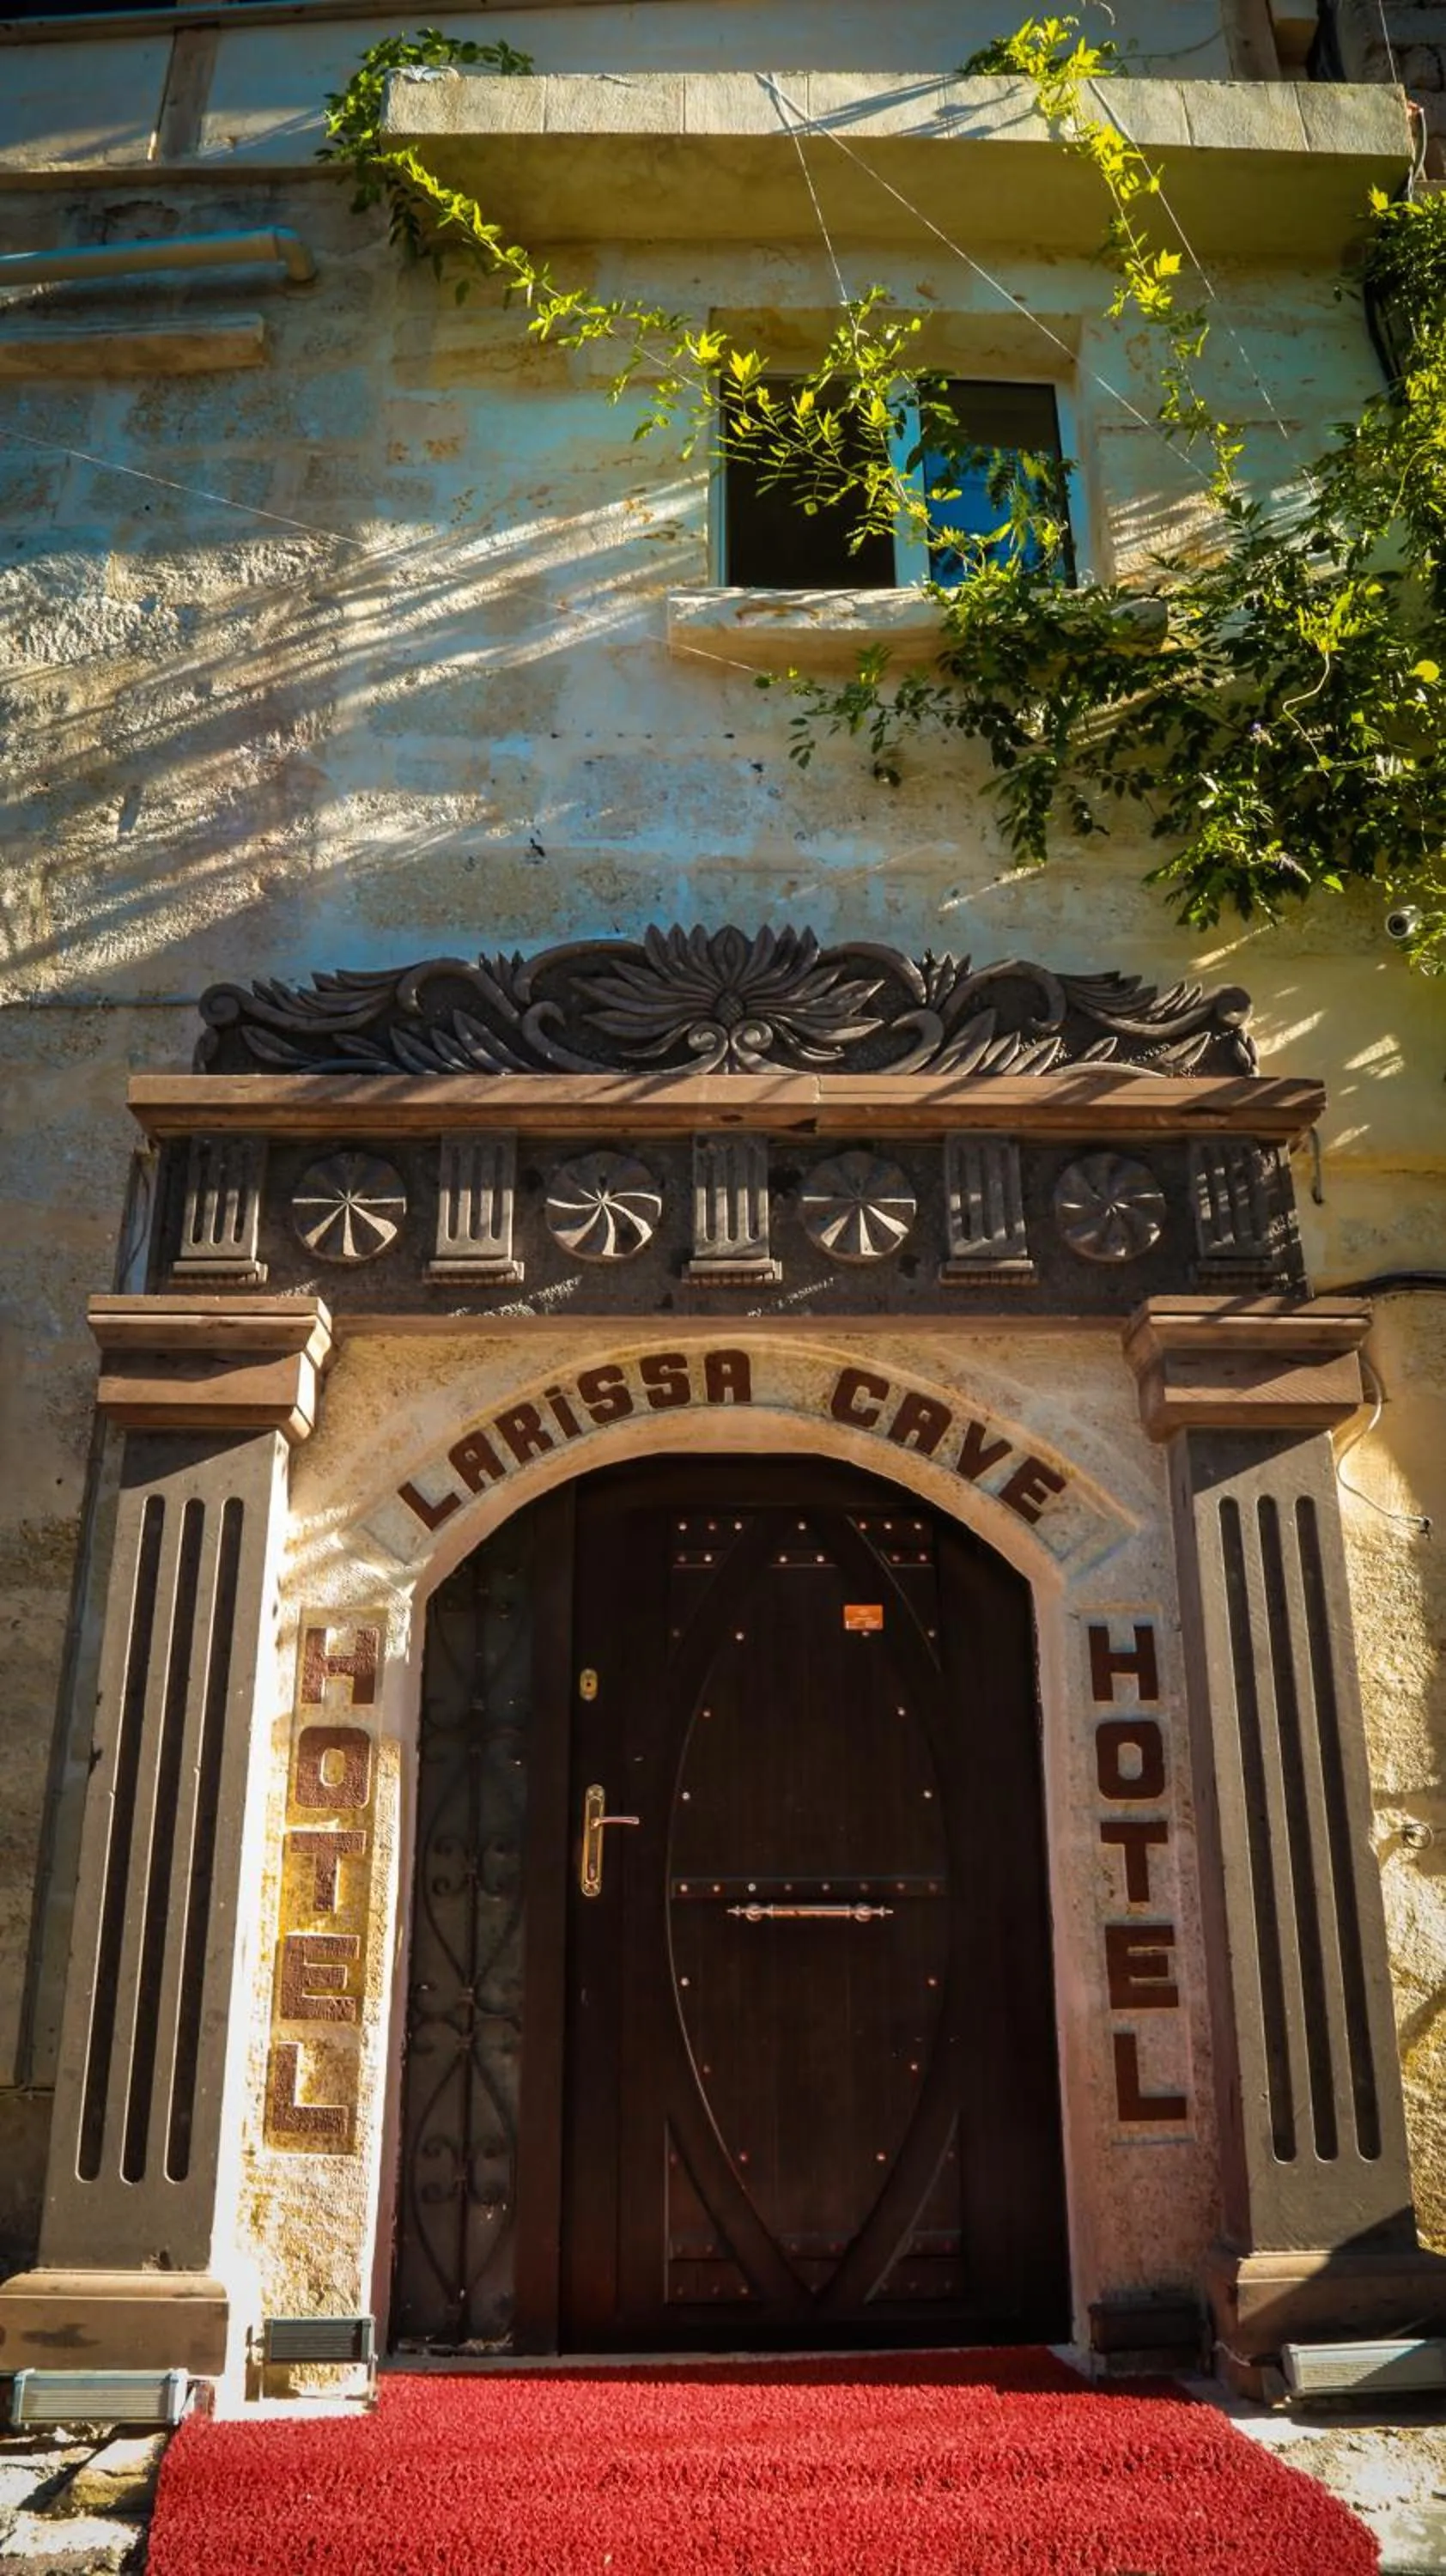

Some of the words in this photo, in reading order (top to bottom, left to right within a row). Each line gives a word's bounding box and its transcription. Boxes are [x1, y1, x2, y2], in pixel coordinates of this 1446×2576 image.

[830, 1367, 1067, 1525] CAVE
[270, 1626, 380, 2134] HOTEL
[1088, 1625, 1188, 2122] HOTEL
